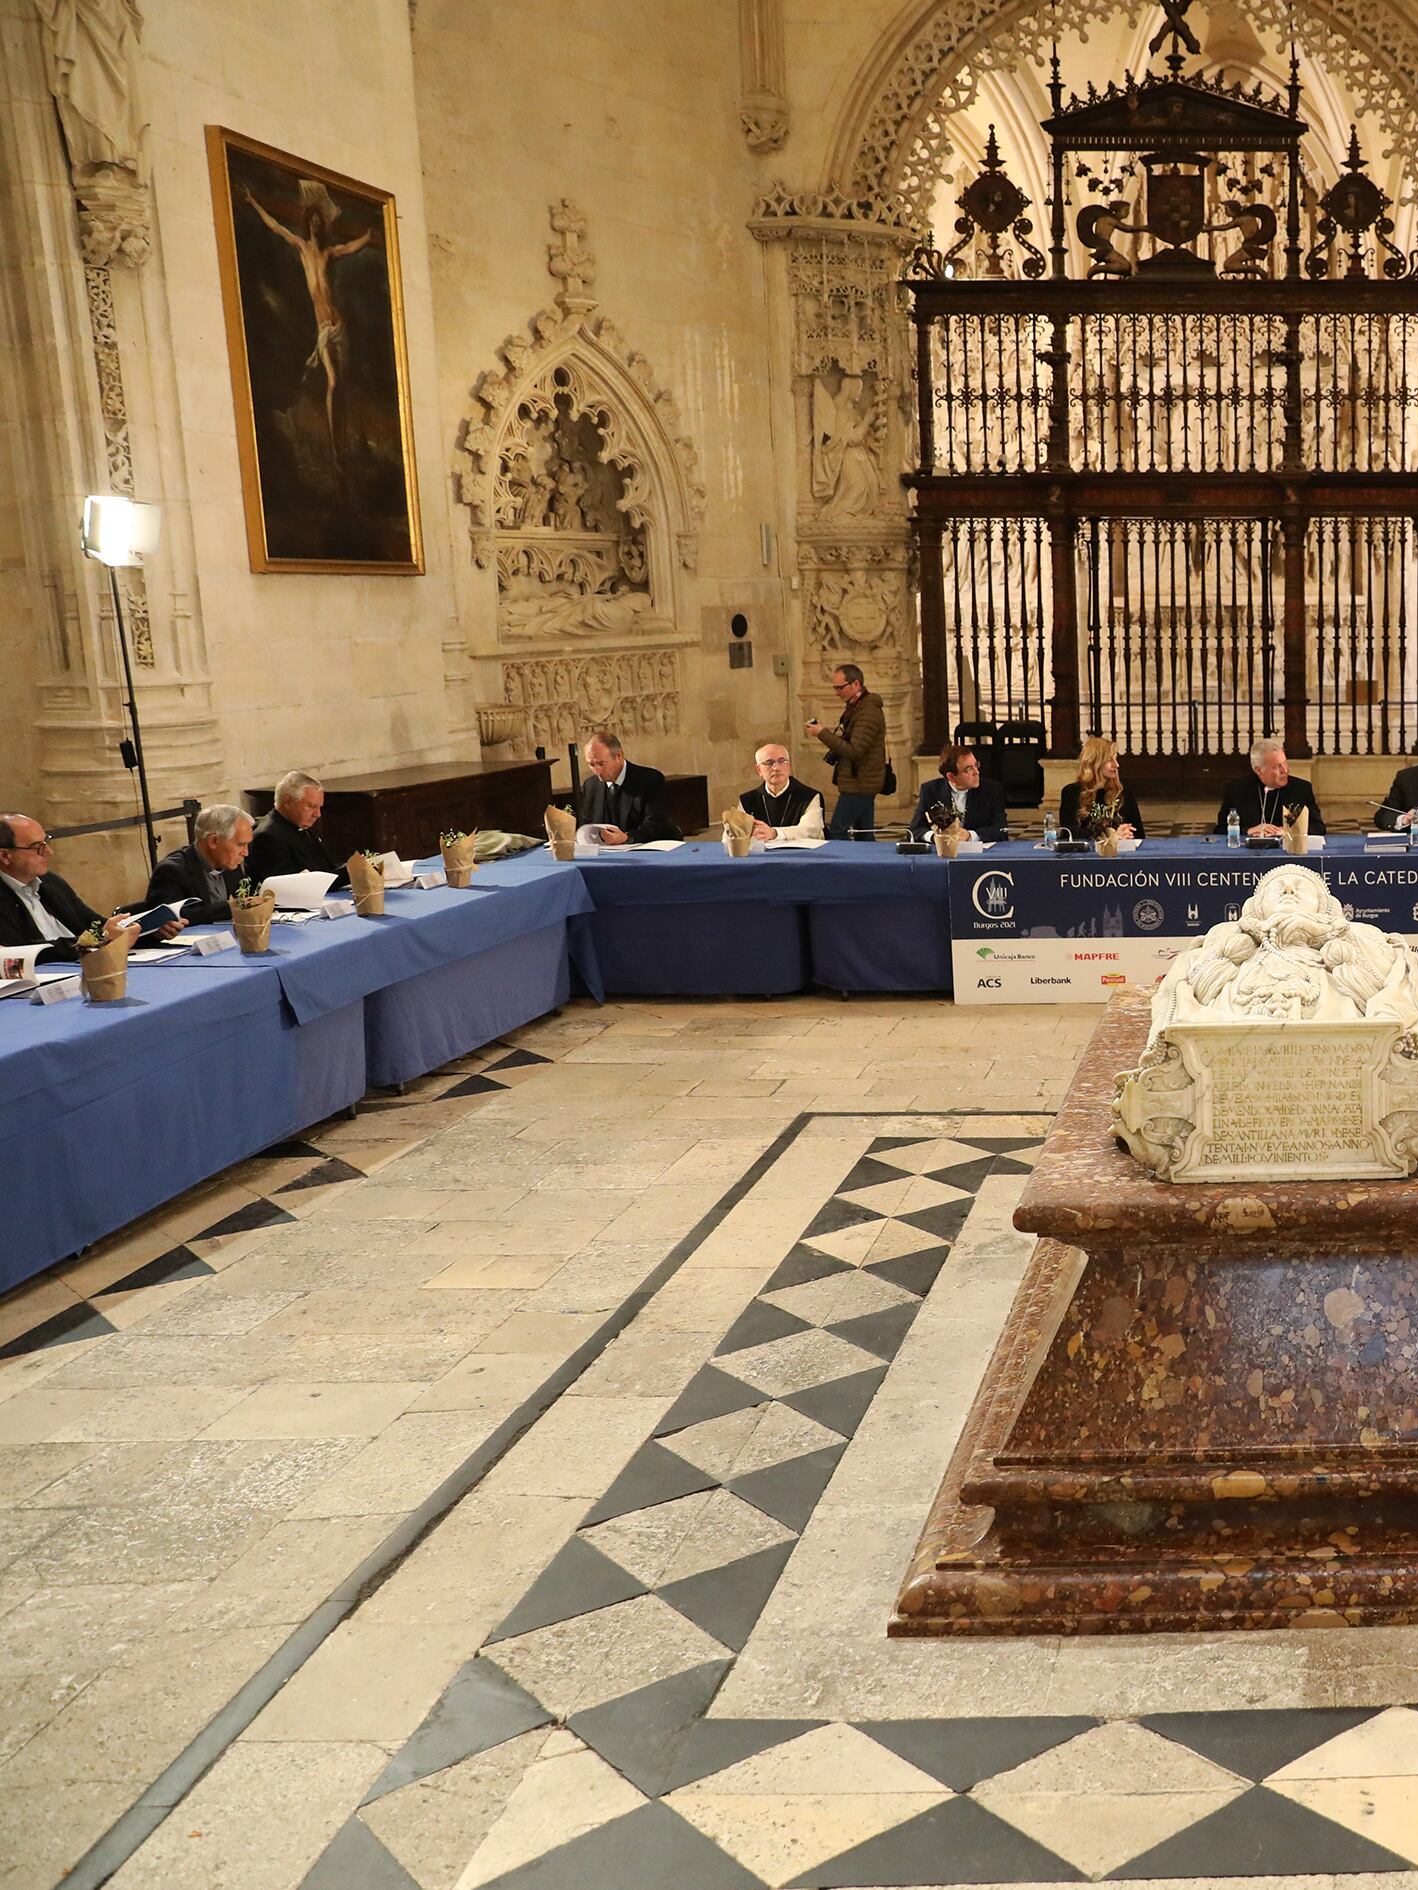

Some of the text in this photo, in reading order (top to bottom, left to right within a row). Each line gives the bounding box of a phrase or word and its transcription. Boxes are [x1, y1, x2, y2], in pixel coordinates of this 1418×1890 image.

[1060, 870, 1159, 888] FUNDACIÓN
[1165, 872, 1191, 887] VIII
[1338, 871, 1359, 885] LA
[994, 953, 1017, 961] Unicaja
[1074, 953, 1120, 961] MAPFRE
[977, 978, 1002, 989] ACS
[1030, 977, 1072, 985] Liberbank
